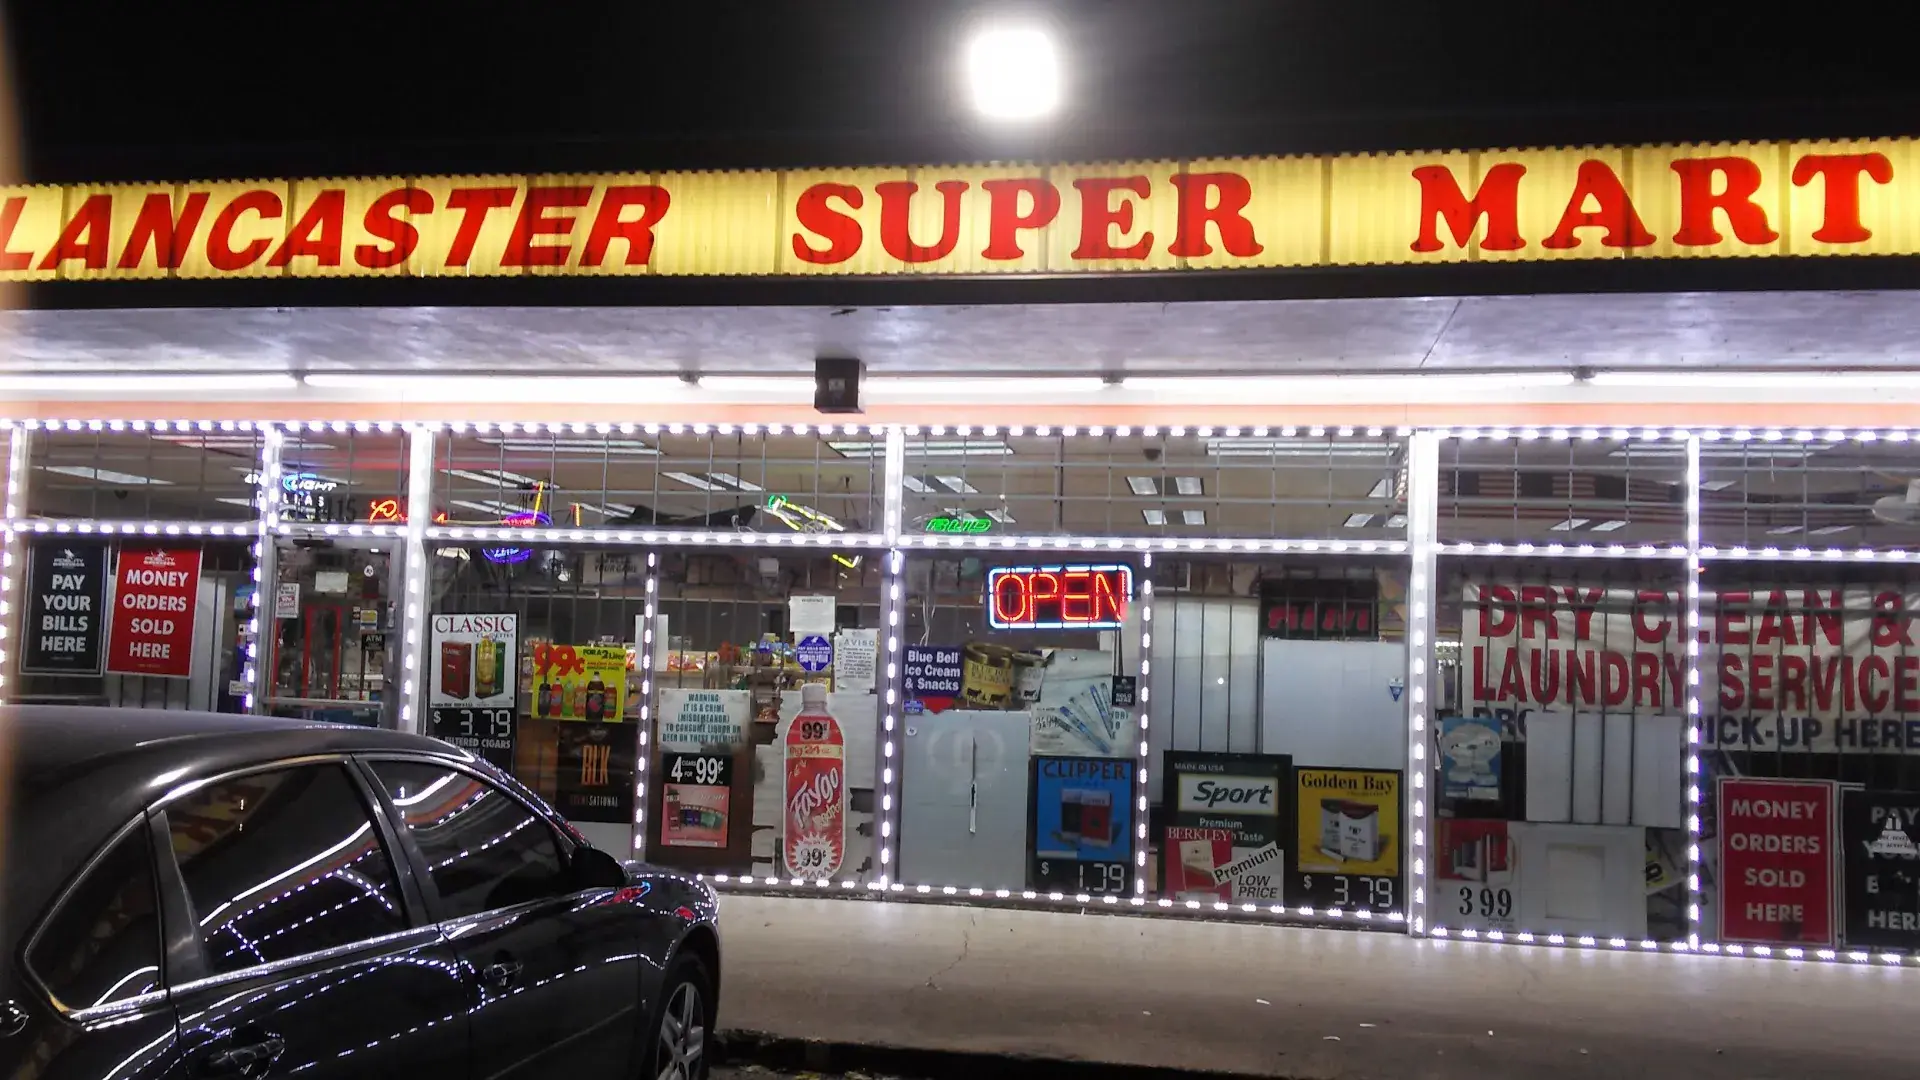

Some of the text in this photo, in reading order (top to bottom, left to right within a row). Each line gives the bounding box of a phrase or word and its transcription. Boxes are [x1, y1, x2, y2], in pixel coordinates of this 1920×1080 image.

[0, 152, 1894, 271] LANCASTER SUPER MART
[52, 574, 85, 590] PAY
[126, 569, 189, 587] MONEY
[42, 594, 91, 611] YOUR
[123, 593, 187, 612] ORDERS
[995, 573, 1126, 622] OPEN
[42, 616, 88, 631] BILLS
[1479, 584, 1914, 647] DRY CLEAN &
[130, 618, 174, 635] SOLD
[435, 616, 514, 634] CLASSIC
[41, 636, 87, 652] HERE
[366, 635, 382, 643] ATM
[129, 641, 171, 659] HERE
[908, 650, 958, 664] Blue Bell
[905, 664, 921, 676] Ice
[925, 665, 960, 678] Cream
[1472, 645, 1920, 714] LAUNDRY SERVICE
[905, 678, 959, 691] & Snacks
[434, 709, 511, 738] $ 3.79
[666, 723, 674, 732] TO
[1698, 715, 1920, 748] ICK-UP HERE
[444, 736, 511, 749] FILTERED CIGARS
[581, 745, 610, 785] BLK
[671, 756, 683, 783] 4
[695, 757, 724, 784] 99¢
[1043, 759, 1128, 780] CLIPPER
[1174, 762, 1224, 772] MADE IN USA
[1301, 773, 1394, 796] Golden Bay
[789, 767, 839, 830] Faygo
[1193, 781, 1273, 808] Sport
[1731, 799, 1818, 819] MONEY
[1200, 817, 1243, 830] Premium
[1168, 827, 1230, 842] BERKLEY
[1240, 831, 1264, 842] Taste
[1730, 832, 1820, 854] ORDERS
[1042, 861, 1050, 876] $
[1214, 847, 1279, 883] Premium
[1238, 875, 1271, 887] LOW
[1745, 868, 1805, 888] SOLD
[1238, 886, 1278, 899] PRICE
[1303, 874, 1393, 908] $ 3.79
[1746, 903, 1804, 922] HERE
[1868, 909, 1920, 931] HER
